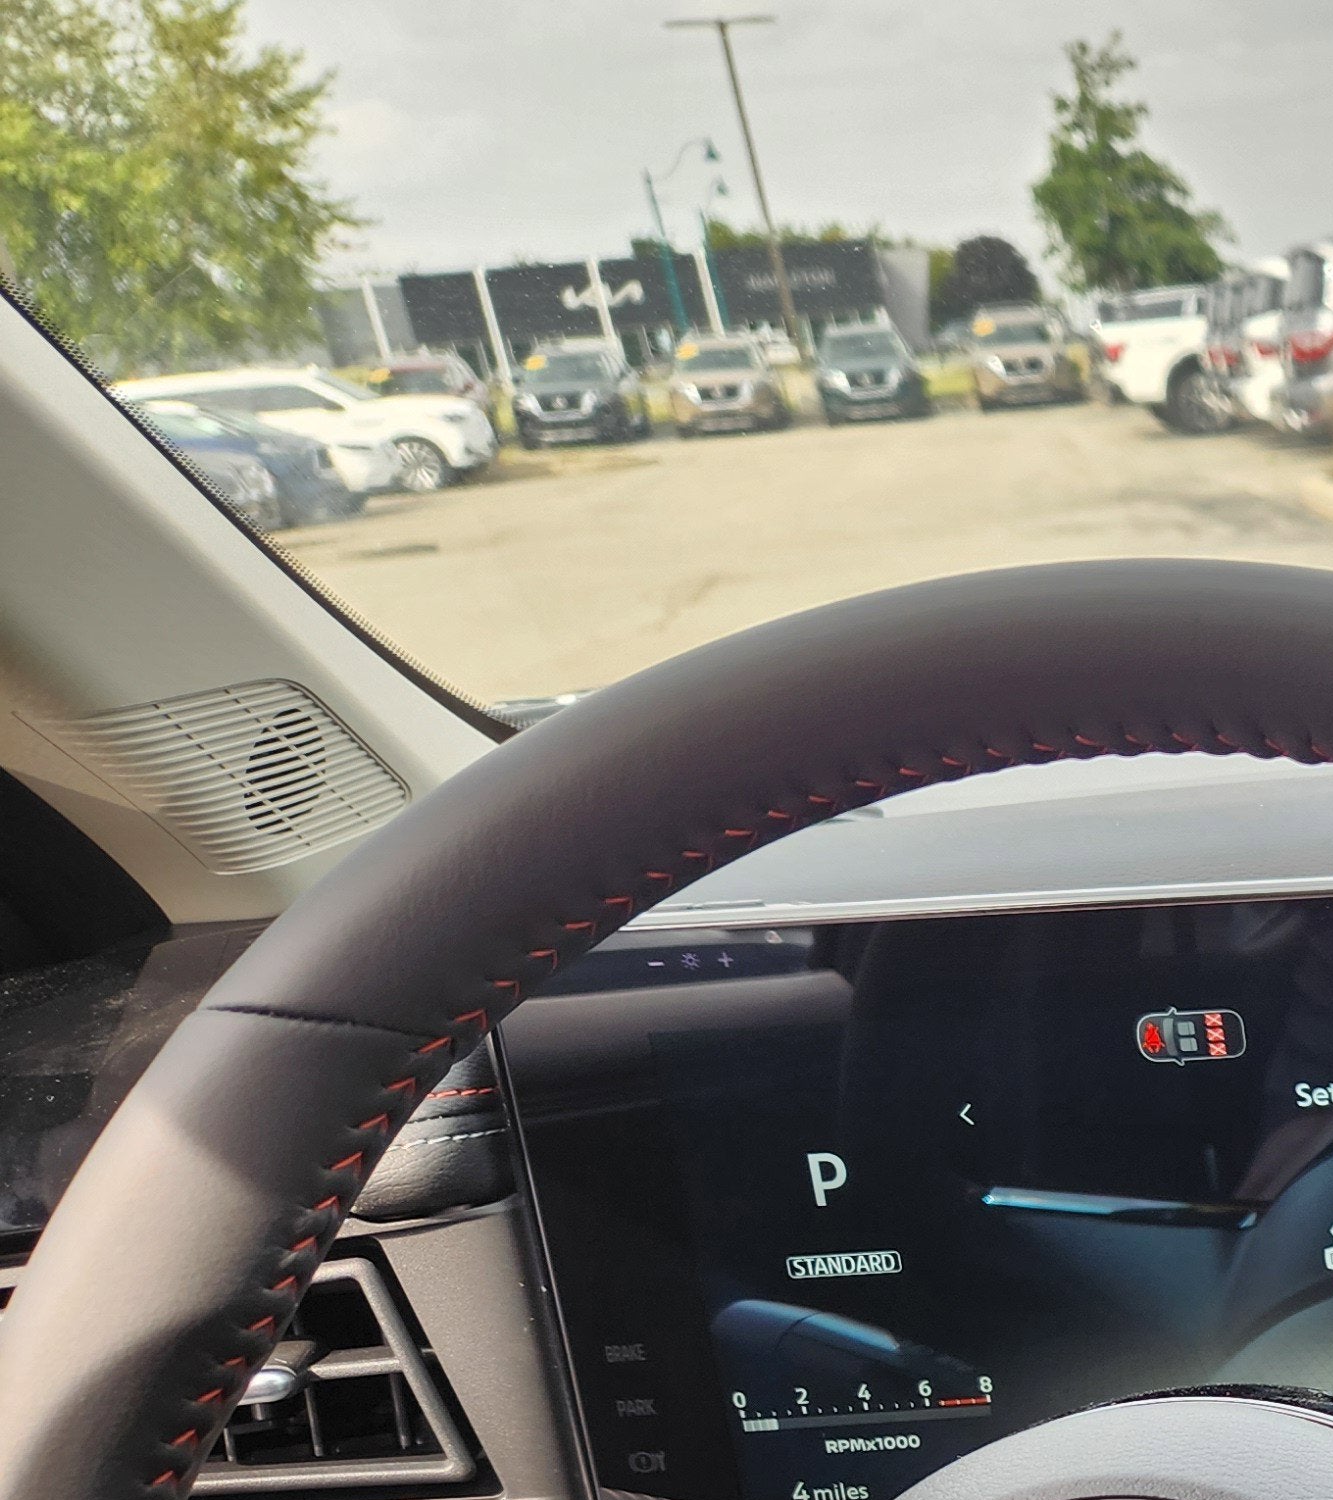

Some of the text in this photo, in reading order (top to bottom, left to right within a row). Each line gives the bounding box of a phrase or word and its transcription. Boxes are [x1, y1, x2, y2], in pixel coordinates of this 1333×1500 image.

[807, 1152, 848, 1207] P
[792, 1253, 897, 1277] STANDARD
[604, 1343, 647, 1364] BRAKE
[732, 1375, 993, 1409] 0 2 4 6 8
[616, 1399, 658, 1418] PARK
[825, 1434, 921, 1455] RPMx1000
